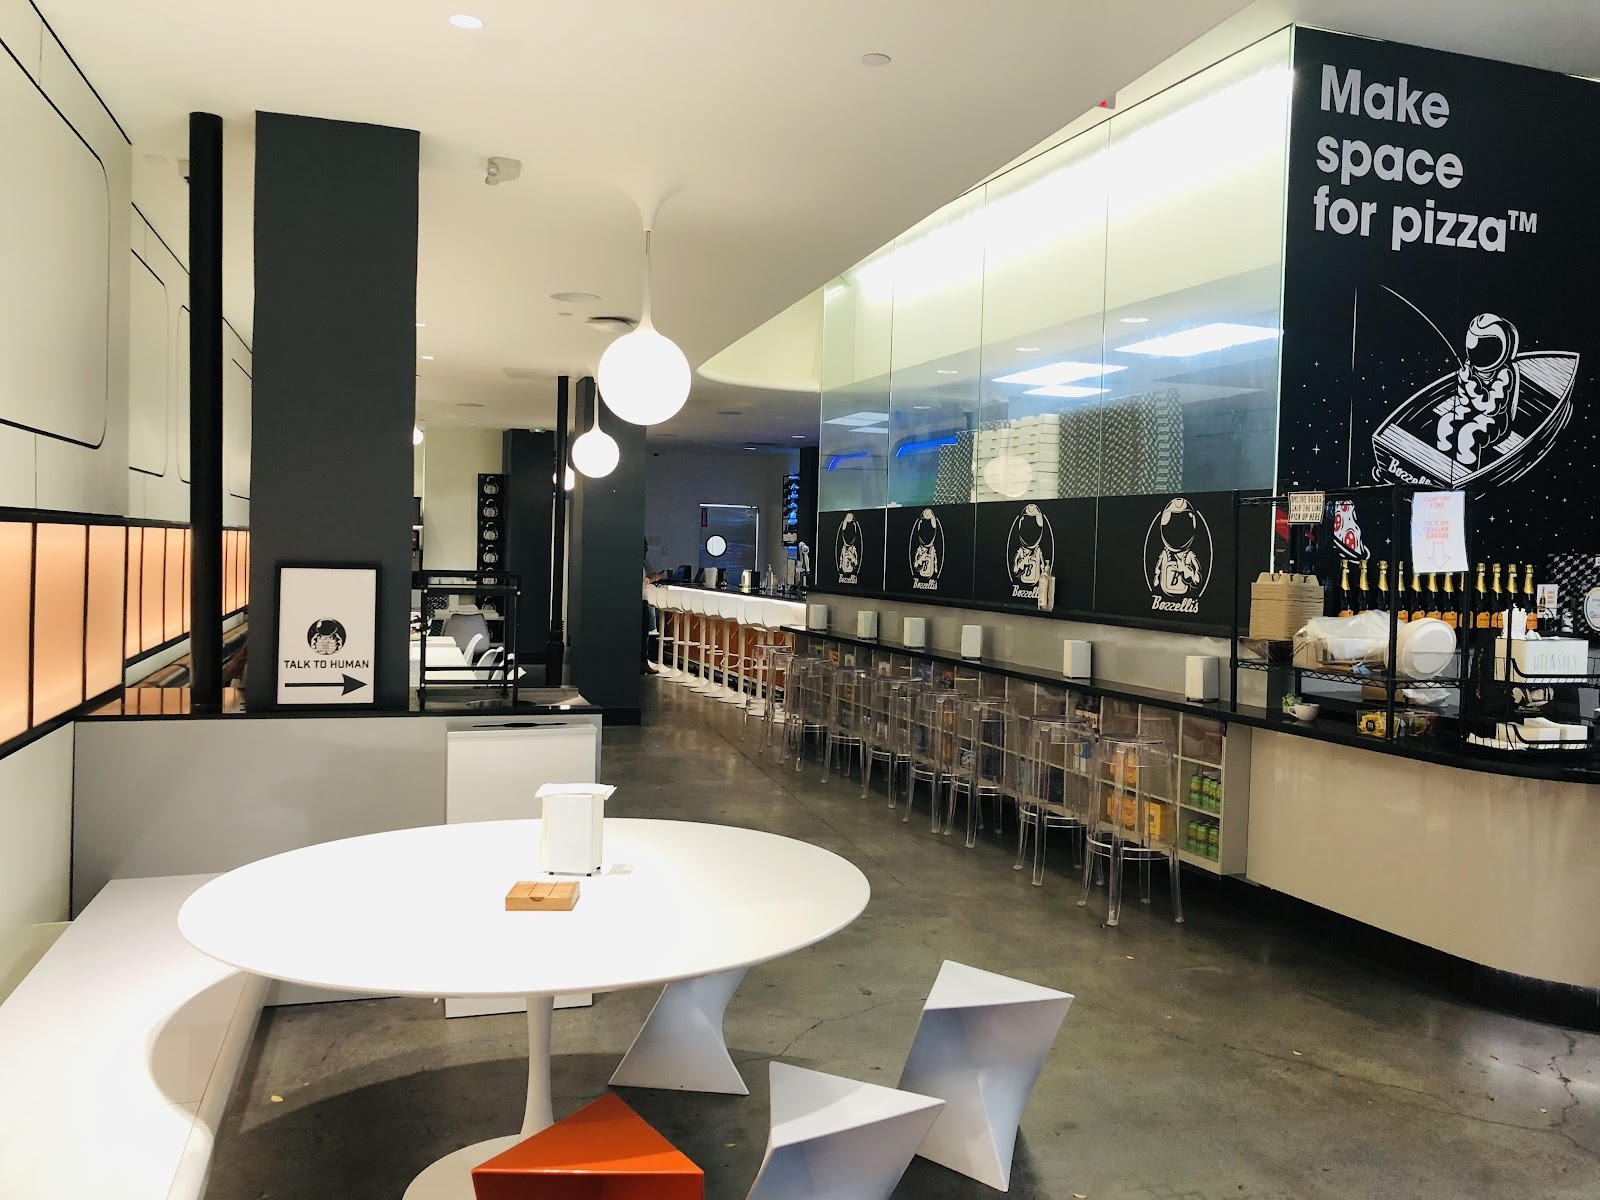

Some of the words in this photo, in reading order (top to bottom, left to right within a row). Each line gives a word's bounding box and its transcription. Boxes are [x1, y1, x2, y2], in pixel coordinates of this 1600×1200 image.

[1321, 64, 1449, 128] Make
[1316, 136, 1464, 188] space
[1313, 185, 1377, 236] for
[1311, 504, 1321, 512] LINE
[1151, 595, 1199, 613] Bozzelli's
[284, 660, 311, 669] TALK
[314, 660, 327, 669] TO
[330, 660, 370, 669] HUMAN
[1533, 653, 1577, 671] UTENSILS
